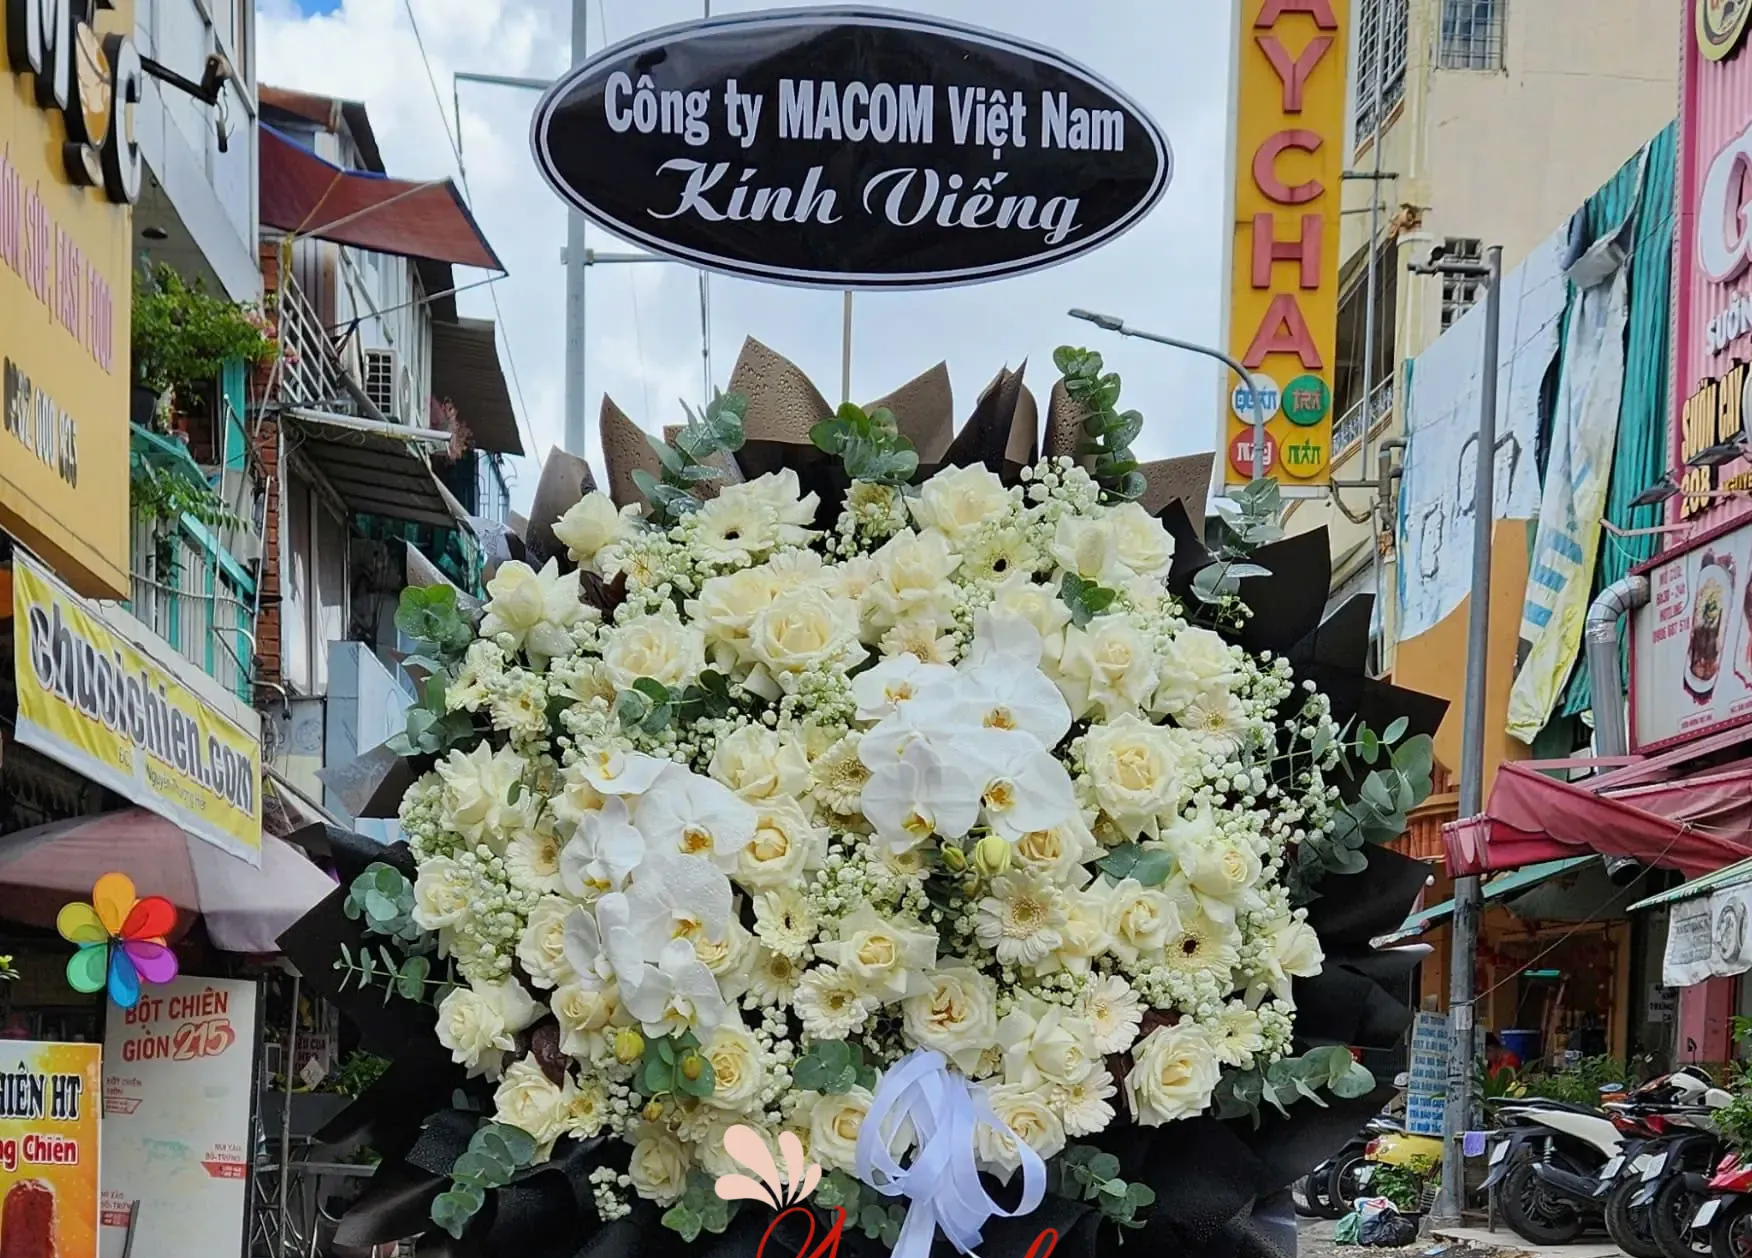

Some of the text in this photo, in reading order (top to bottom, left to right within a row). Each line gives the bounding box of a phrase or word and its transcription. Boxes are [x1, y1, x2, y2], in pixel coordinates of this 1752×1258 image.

[604, 71, 1125, 160] Công ty MACOM Việt Nam
[646, 158, 1083, 244] Kính Viếng
[168, 986, 229, 1020] CHIÊN
[122, 1018, 235, 1062] GIÒN 215
[51, 1075, 80, 1118] HT
